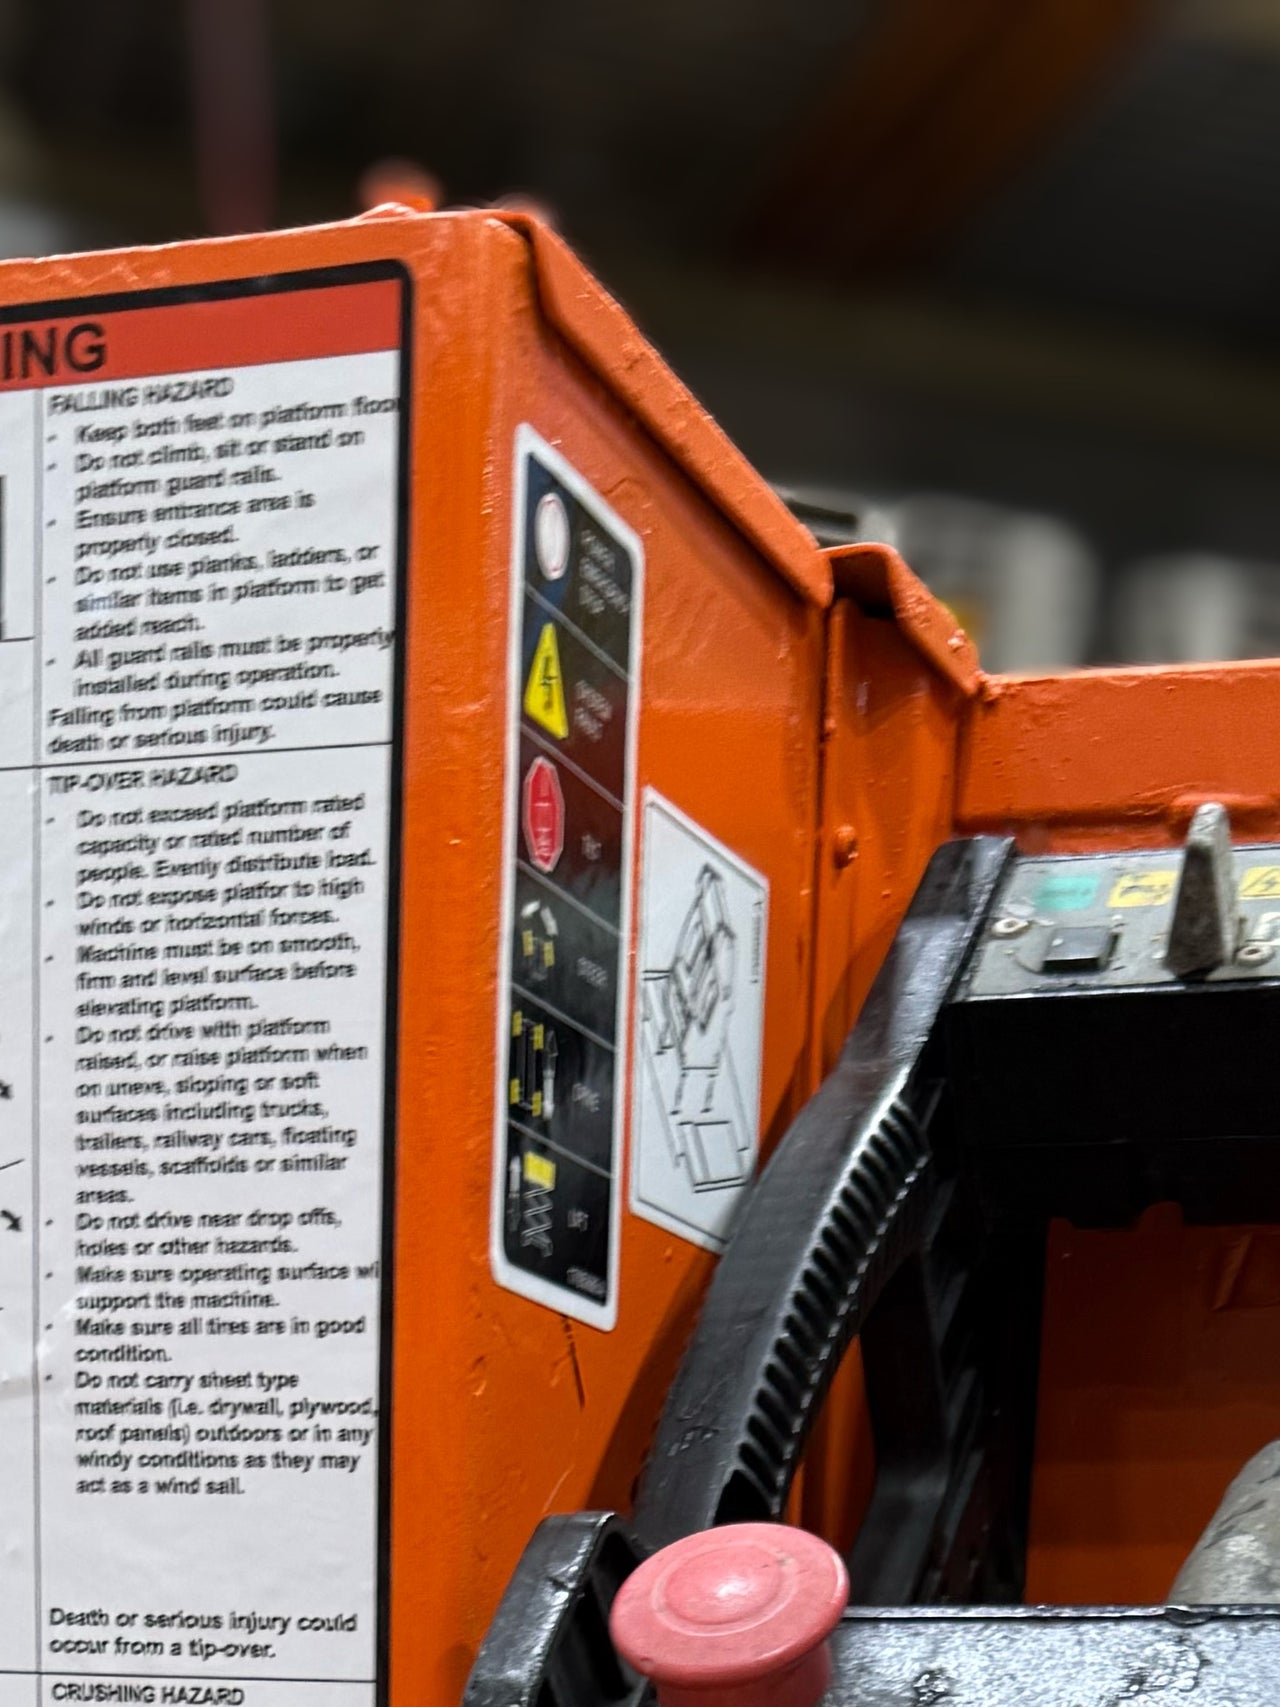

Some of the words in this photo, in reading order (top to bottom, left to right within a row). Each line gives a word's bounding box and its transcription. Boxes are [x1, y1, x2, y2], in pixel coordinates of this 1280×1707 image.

[48, 385, 139, 413] FALLING
[142, 375, 234, 404] HAZARD
[46, 769, 145, 793] TIP-OVER
[148, 762, 238, 787] HAZARD
[75, 1476, 106, 1494] act
[109, 1479, 133, 1494] as
[136, 1479, 149, 1494] a
[153, 1475, 201, 1495] wind
[204, 1476, 245, 1495] sail.
[48, 1606, 110, 1627] Death
[114, 1612, 139, 1628] or
[142, 1609, 224, 1630] serious
[228, 1610, 292, 1636] injury
[296, 1612, 358, 1632] could
[48, 1638, 110, 1655] occur
[113, 1635, 165, 1656] from
[169, 1641, 182, 1657] a
[187, 1637, 276, 1661] tip-over.
[50, 1681, 156, 1704] CRUSHING
[160, 1685, 245, 1706] HAZARD
